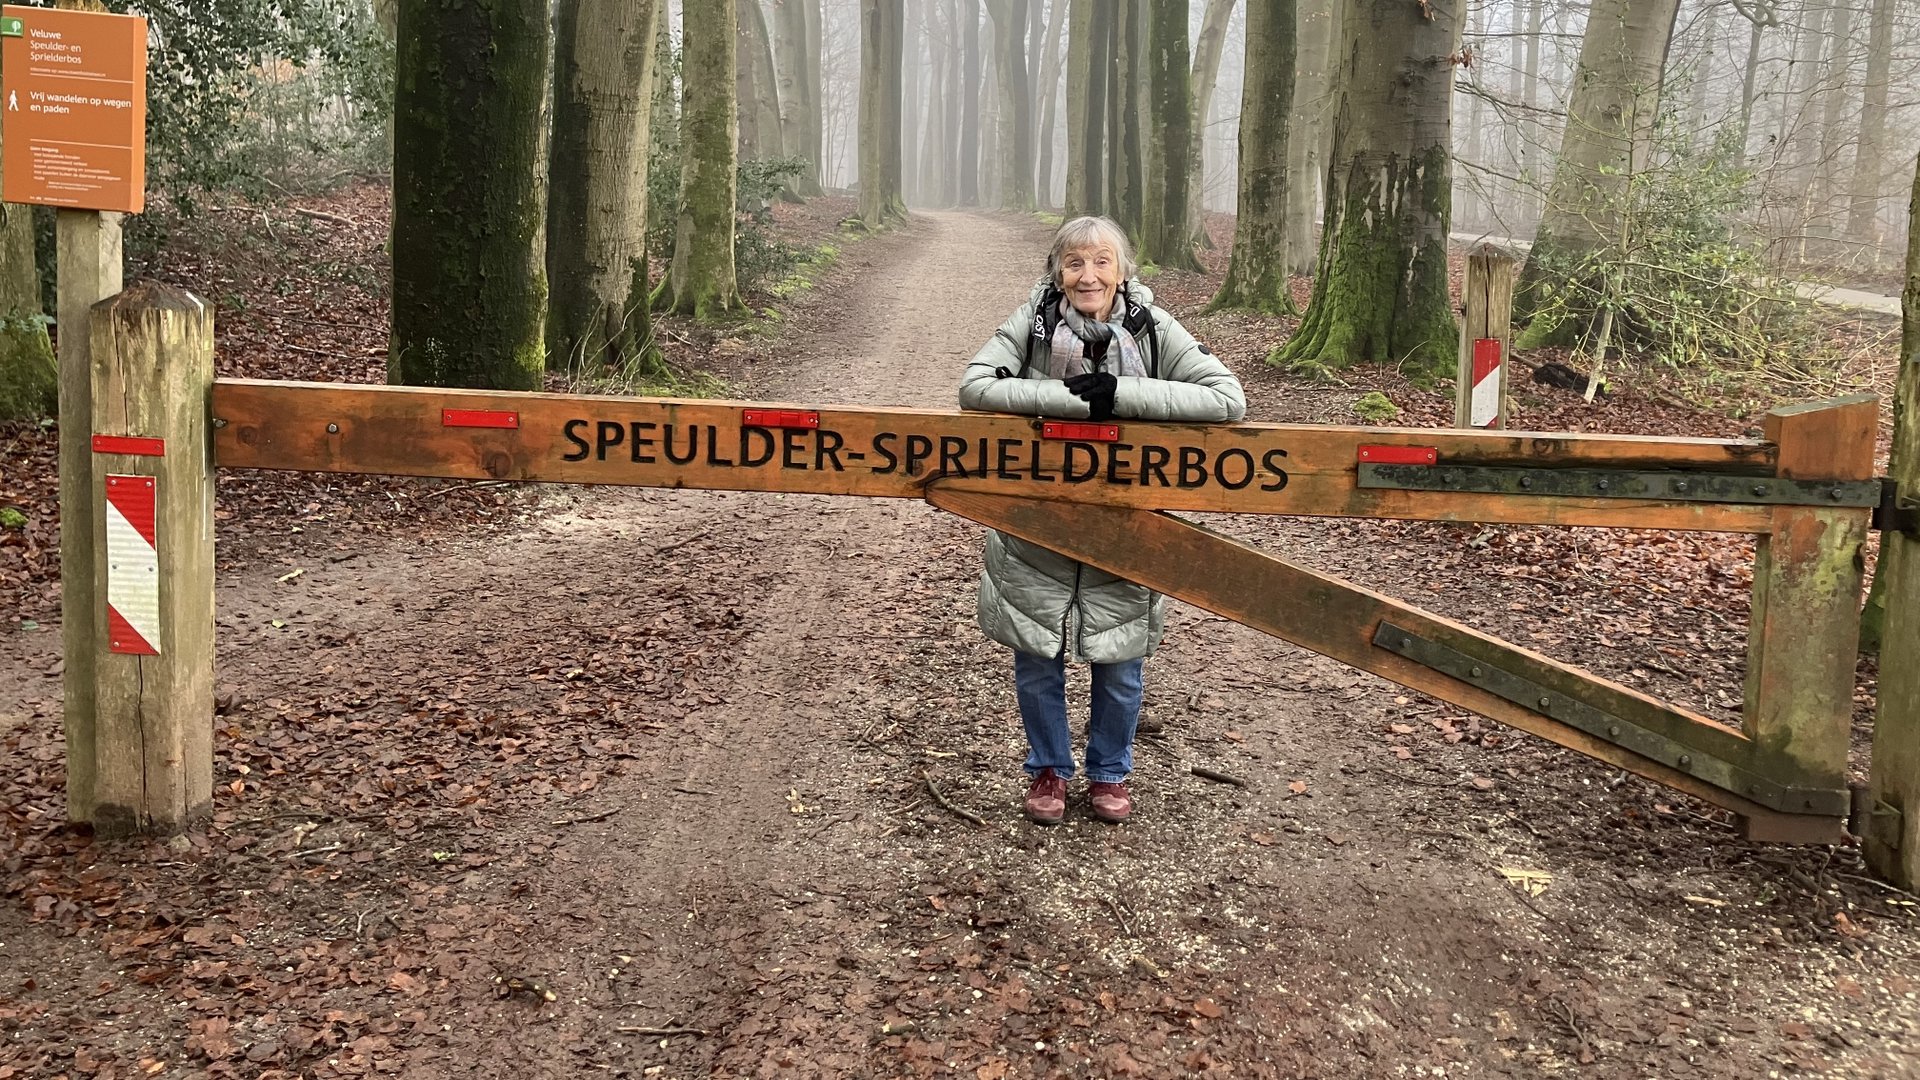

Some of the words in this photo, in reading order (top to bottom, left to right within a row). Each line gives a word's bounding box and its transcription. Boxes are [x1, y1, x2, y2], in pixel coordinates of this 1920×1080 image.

[30, 28, 62, 39] Veluwe
[30, 40, 69, 50] Speulder-
[70, 45, 82, 53] en
[30, 51, 82, 64] Sprielderbos
[30, 91, 45, 102] Vrij
[46, 94, 88, 104] wandelen
[89, 97, 101, 107] op
[103, 99, 132, 109] wegen
[43, 104, 70, 114] paden
[562, 419, 1290, 492] SPEULDER-SPRIELDERBOS
